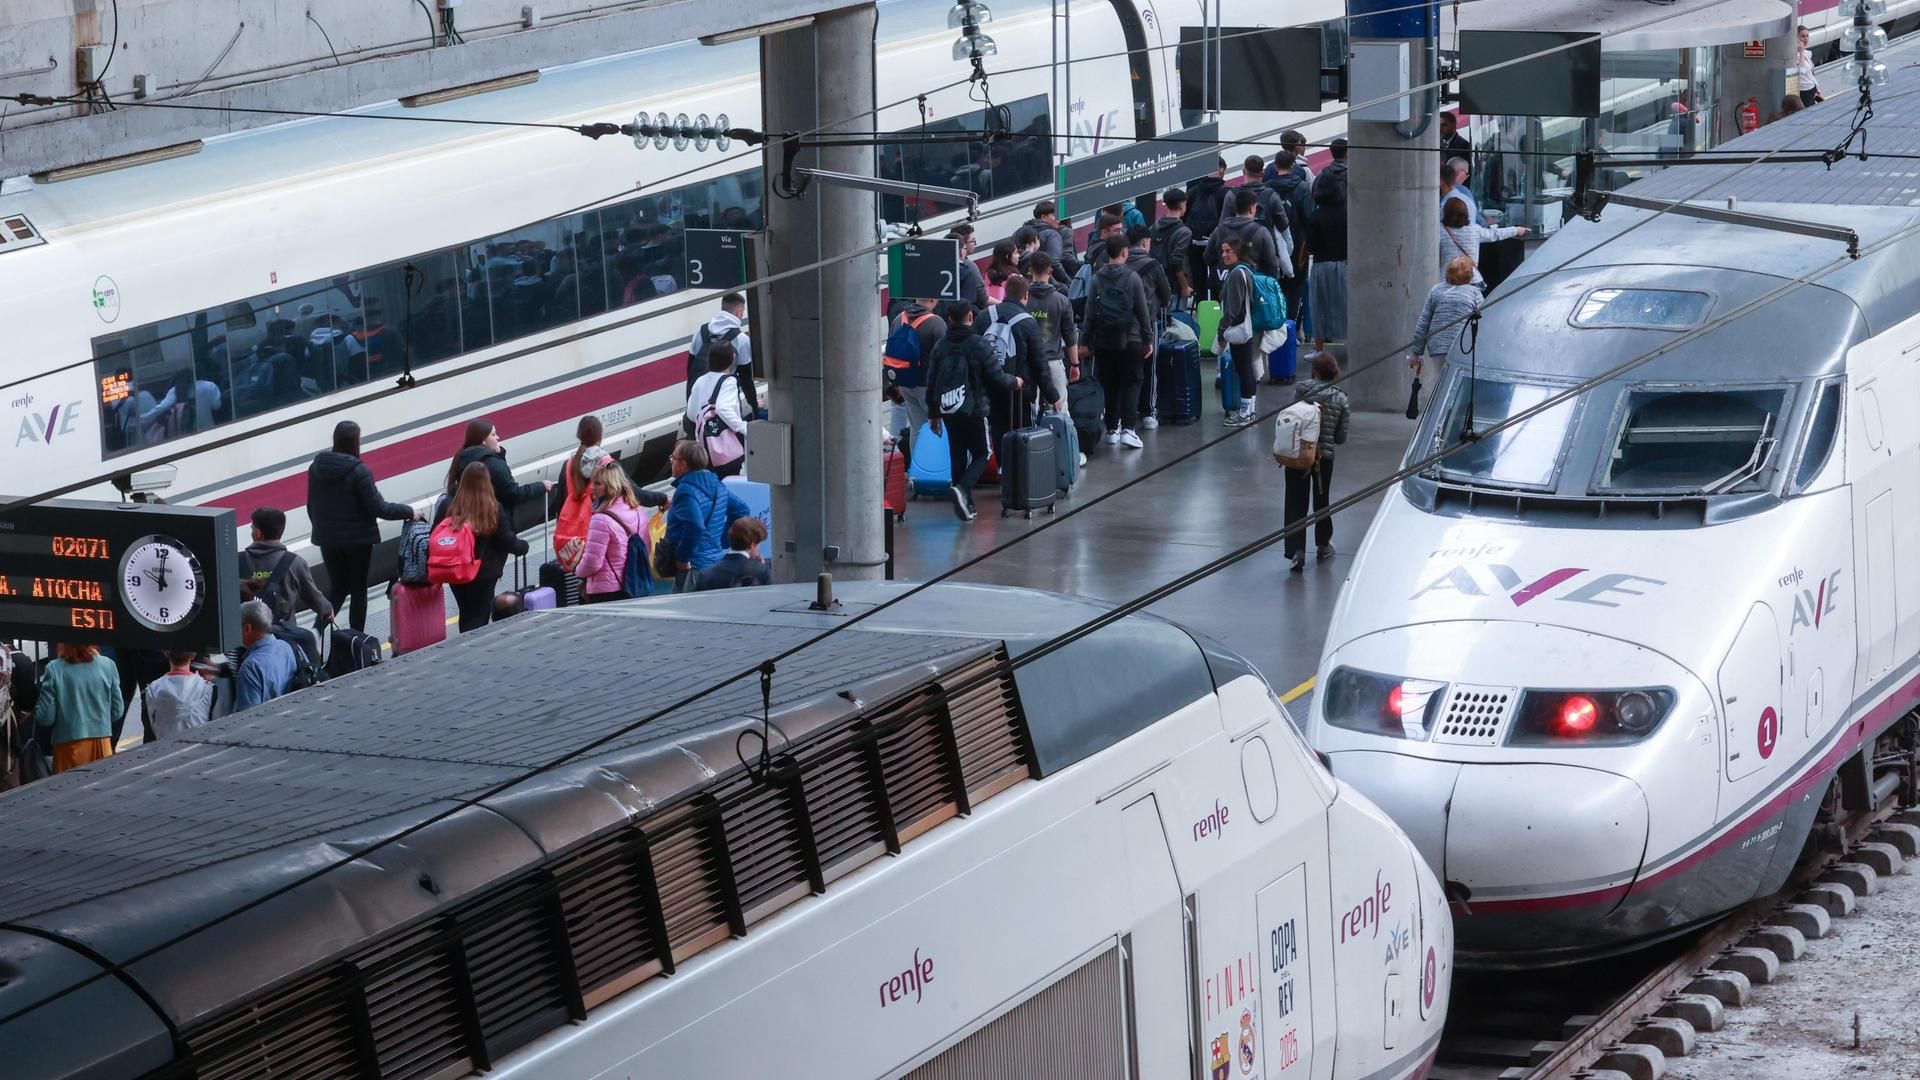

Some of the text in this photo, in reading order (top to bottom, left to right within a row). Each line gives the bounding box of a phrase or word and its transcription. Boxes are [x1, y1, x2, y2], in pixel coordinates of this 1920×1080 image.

[1072, 110, 1119, 155] AVE
[690, 259, 703, 285] 3
[940, 270, 953, 296] 2
[12, 392, 34, 408] renfe
[941, 385, 966, 408] NIKE
[16, 400, 82, 447] AVE
[52, 536, 110, 559] 02071
[154, 548, 169, 559] 12
[1428, 542, 1504, 559] renfe
[32, 577, 103, 601] ATOCHA
[132, 576, 141, 587] 9
[185, 579, 194, 590] 3
[1407, 563, 1668, 608] AVE
[1778, 565, 1804, 587] renfe
[160, 607, 169, 618] 6
[1790, 568, 1841, 636] AVE
[1193, 798, 1230, 842] renfe
[1341, 868, 1392, 944] renfe
[1271, 918, 1297, 974] COPA
[1384, 922, 1409, 966] AVE
[879, 946, 935, 1008] renfe
[1206, 952, 1255, 1022] FINAL
[1278, 979, 1294, 1019] REY
[1280, 1028, 1298, 1071] 2025
